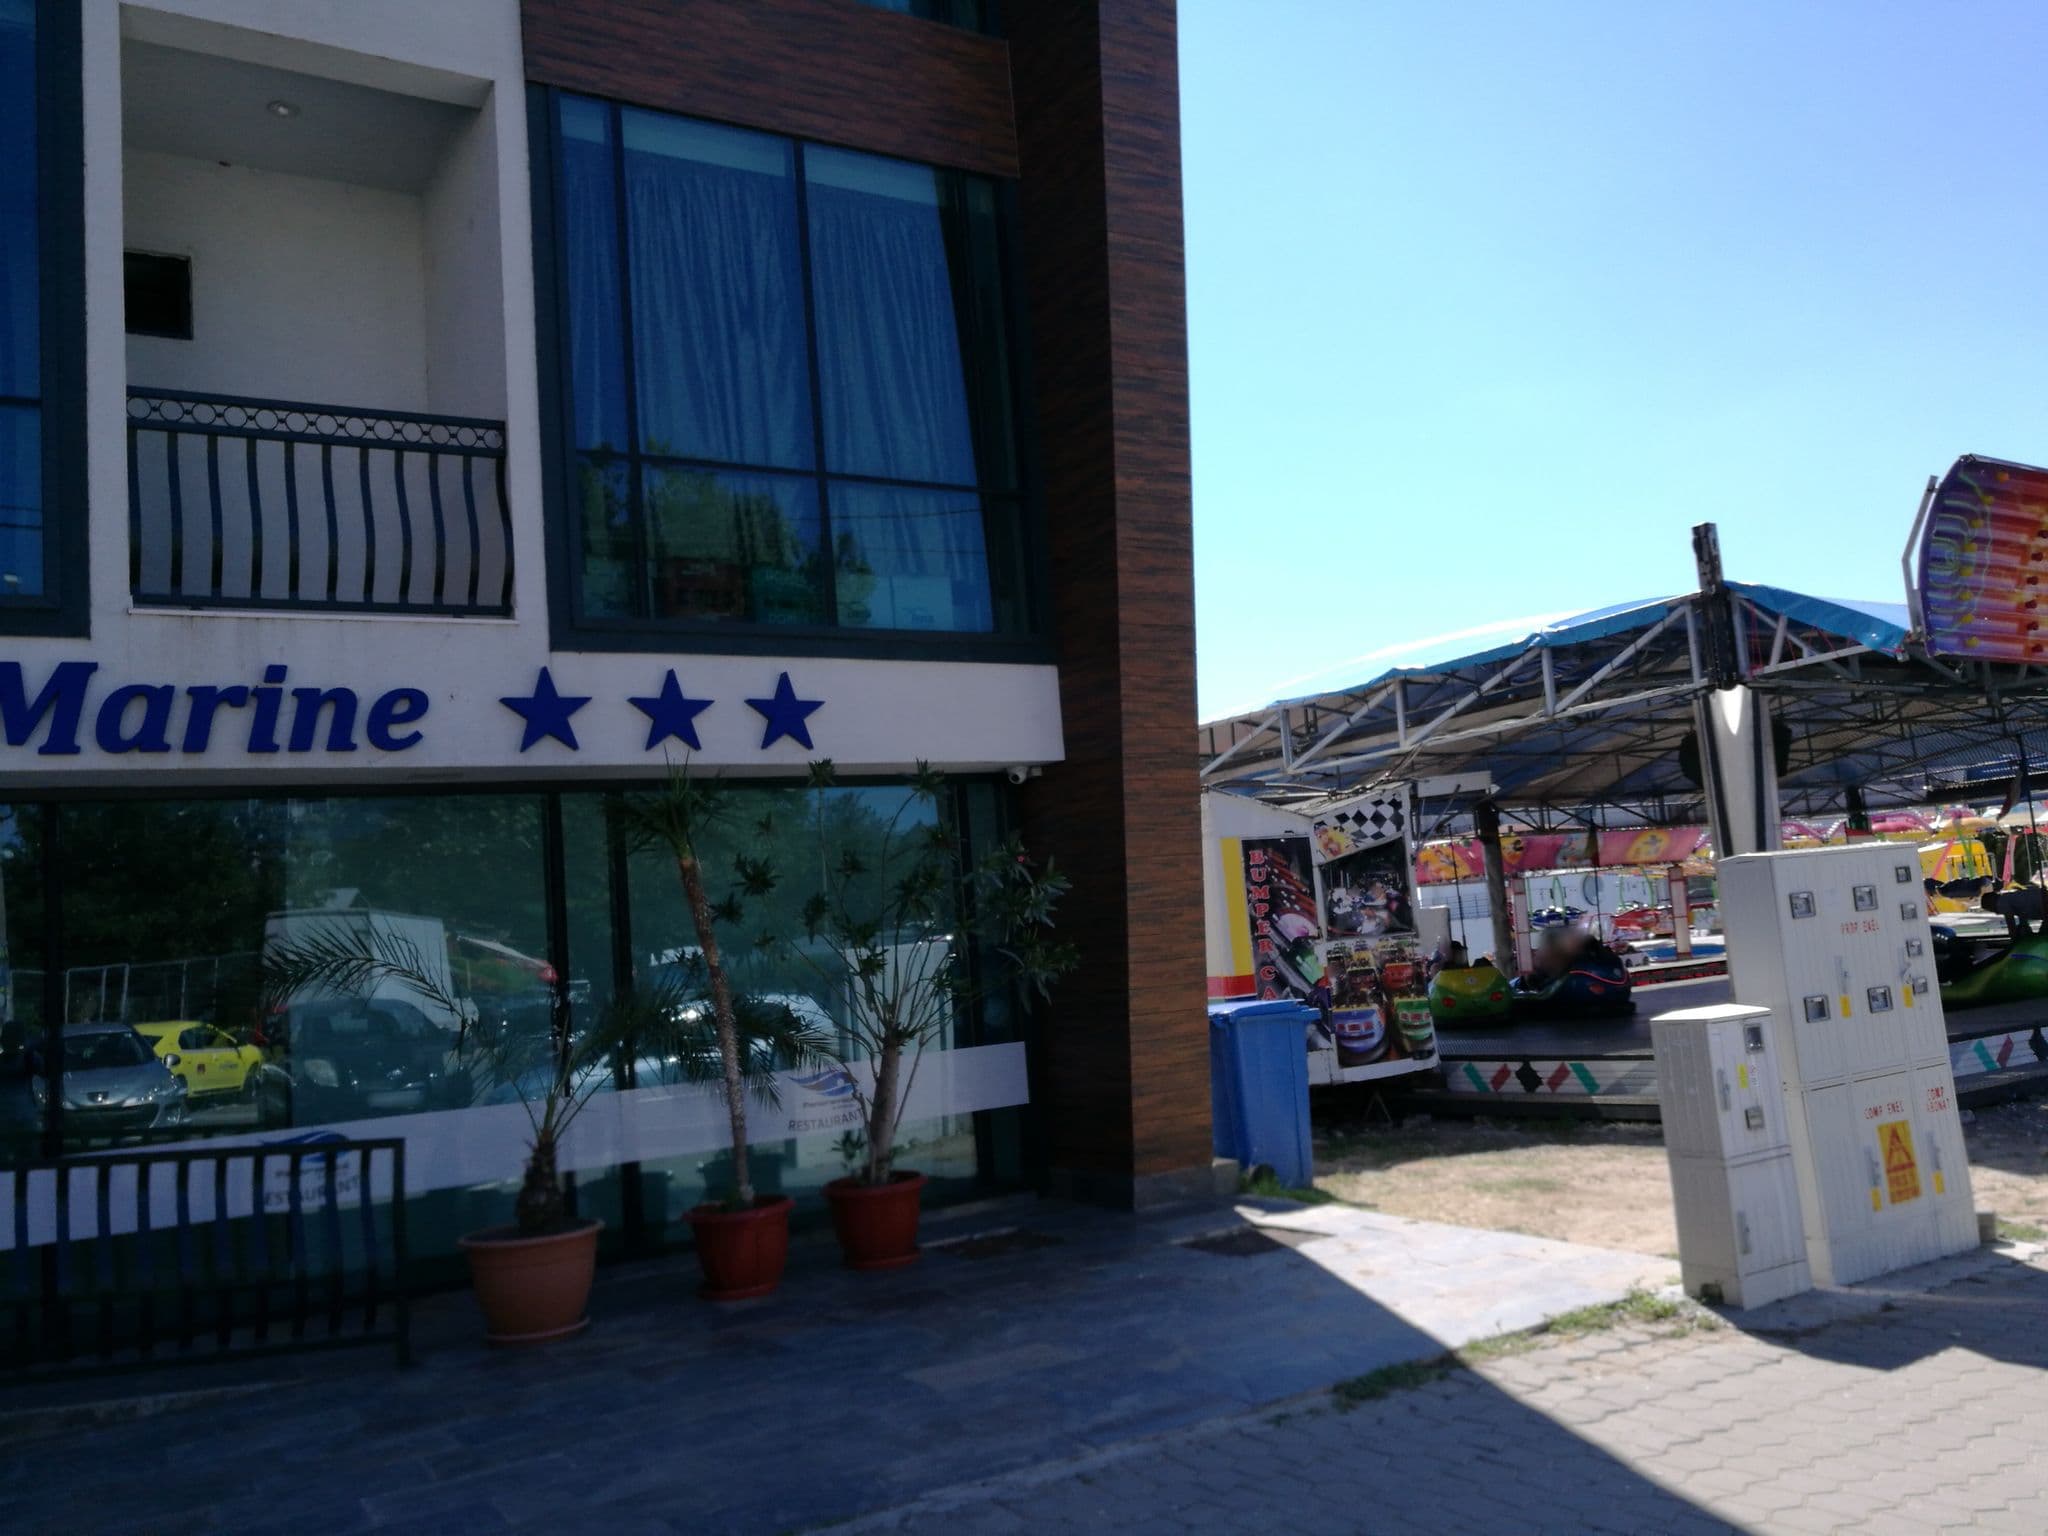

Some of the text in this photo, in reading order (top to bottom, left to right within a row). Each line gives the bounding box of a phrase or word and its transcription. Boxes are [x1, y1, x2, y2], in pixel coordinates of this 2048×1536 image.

[0, 662, 429, 755] Marine
[1250, 851, 1273, 953] BUMPER
[788, 1110, 864, 1130] RESTAURANT
[1886, 1100, 1905, 1114] ENEL
